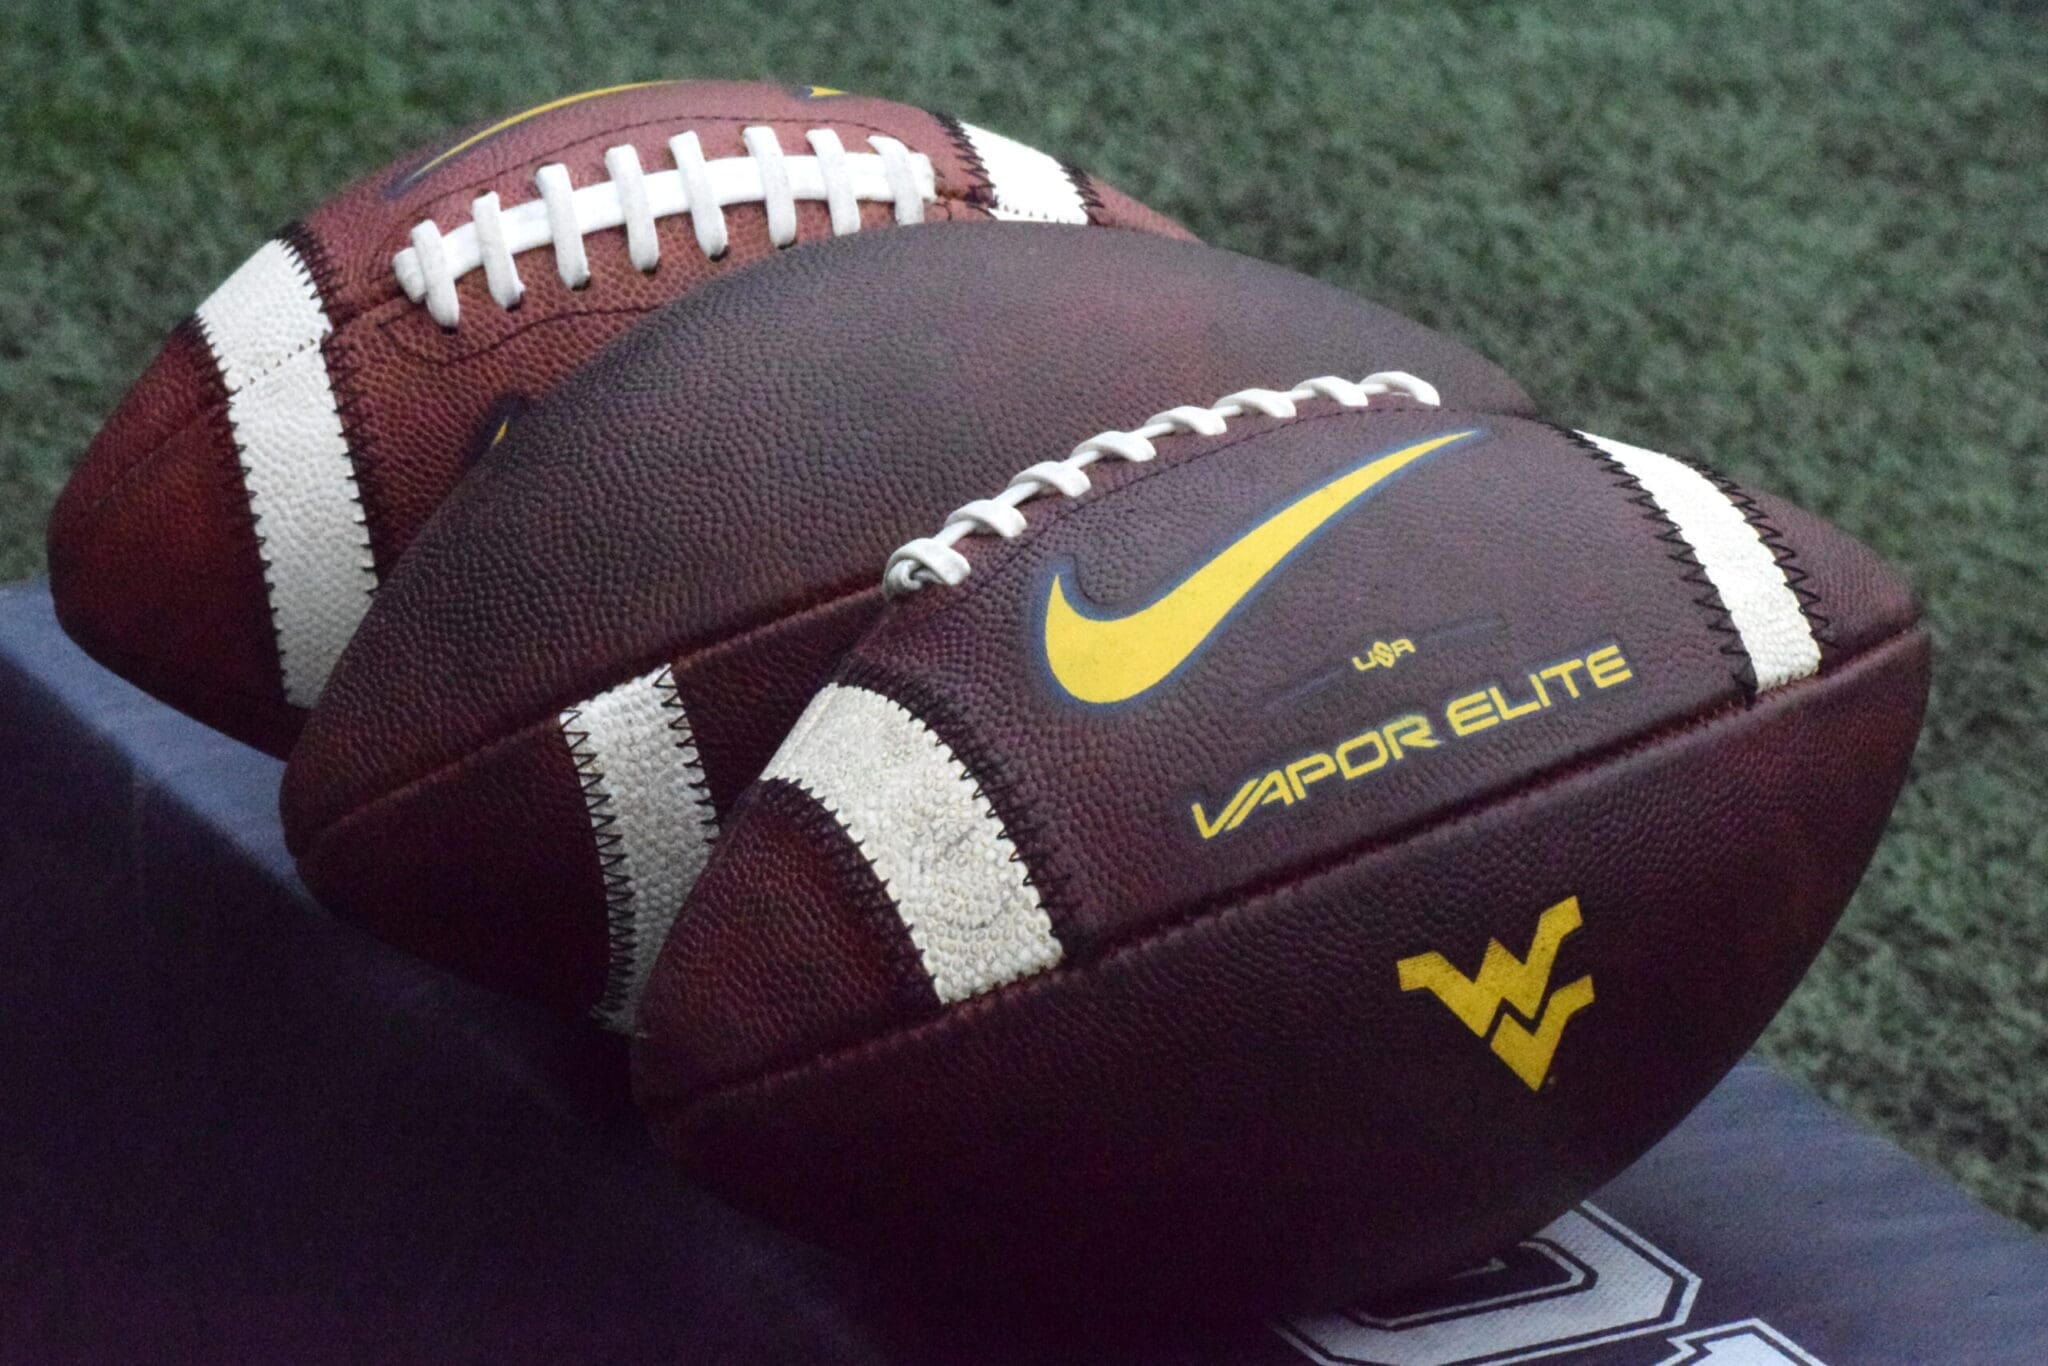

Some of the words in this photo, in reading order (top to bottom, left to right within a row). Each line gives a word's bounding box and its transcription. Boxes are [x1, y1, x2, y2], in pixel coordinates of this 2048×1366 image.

[1351, 638, 1417, 671] USA
[1192, 714, 1442, 839] VAPOR
[1446, 645, 1633, 737] ELITE
